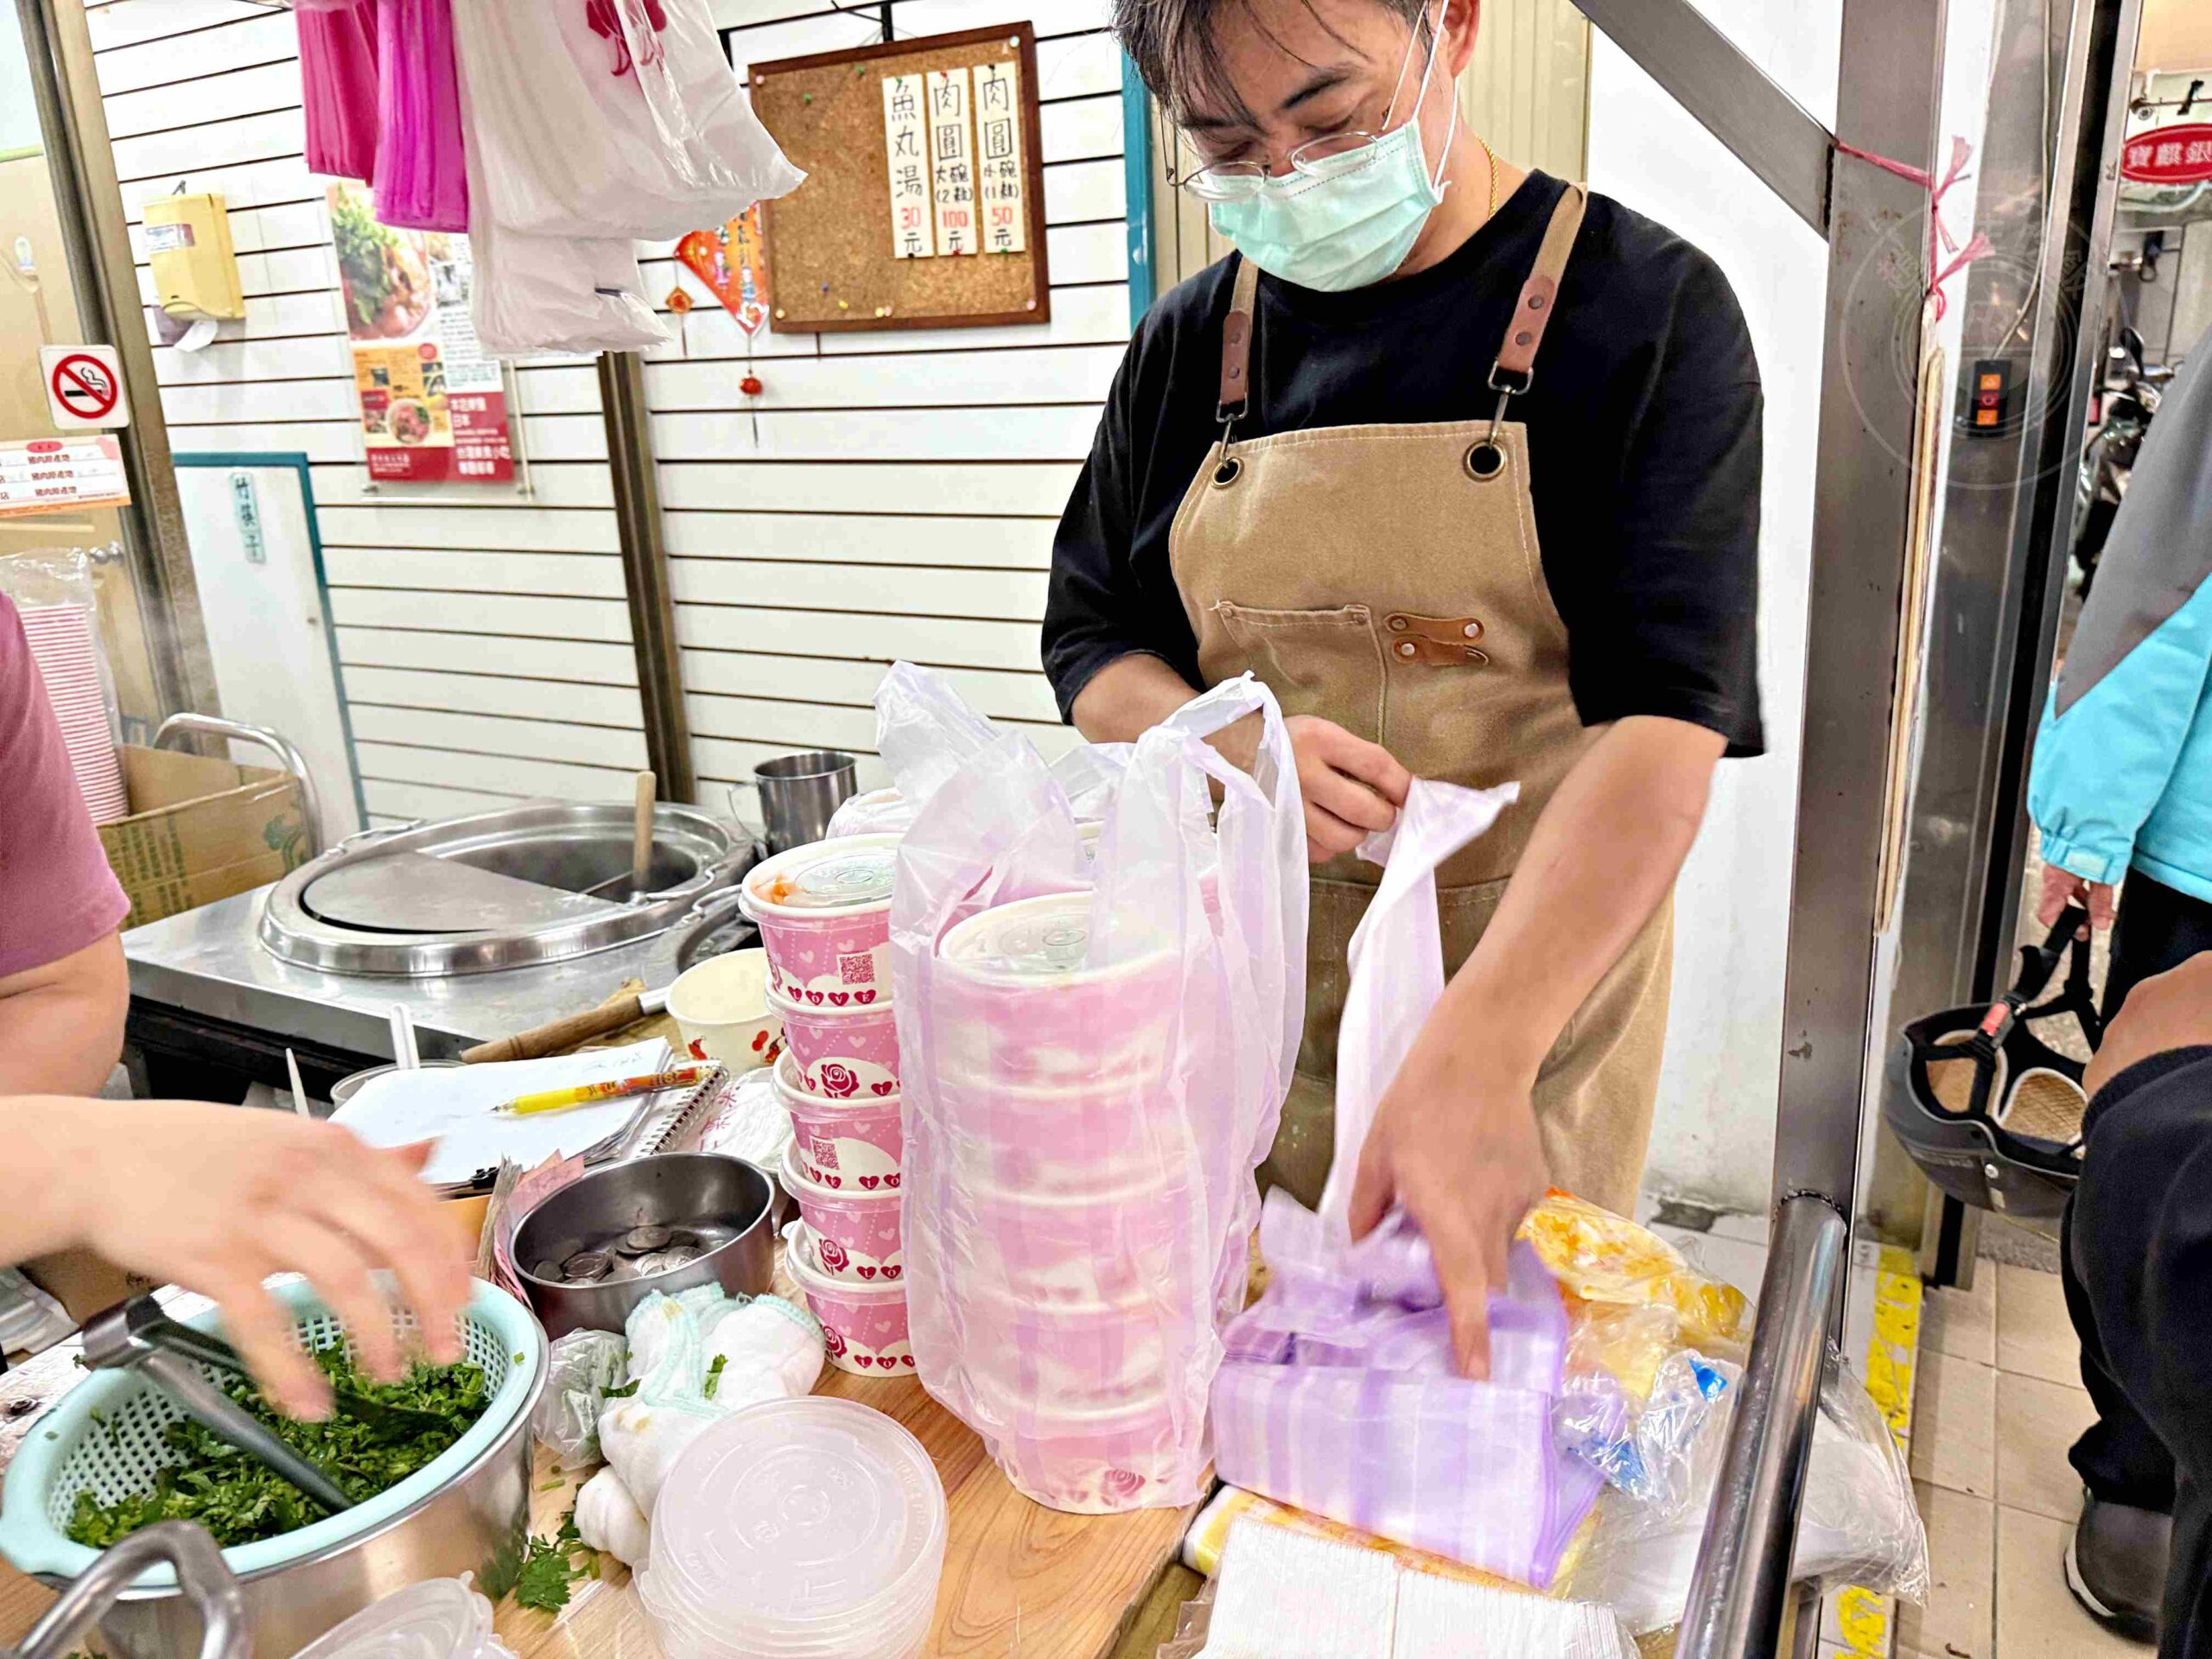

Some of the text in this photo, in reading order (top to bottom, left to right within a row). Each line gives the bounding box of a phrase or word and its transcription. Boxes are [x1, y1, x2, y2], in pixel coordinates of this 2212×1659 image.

[891, 84, 924, 198] 魚丸湯
[934, 79, 963, 161] 肉圓
[982, 74, 1013, 160] 肉圓
[935, 163, 969, 184] 大碗
[984, 160, 1018, 179] 小碗
